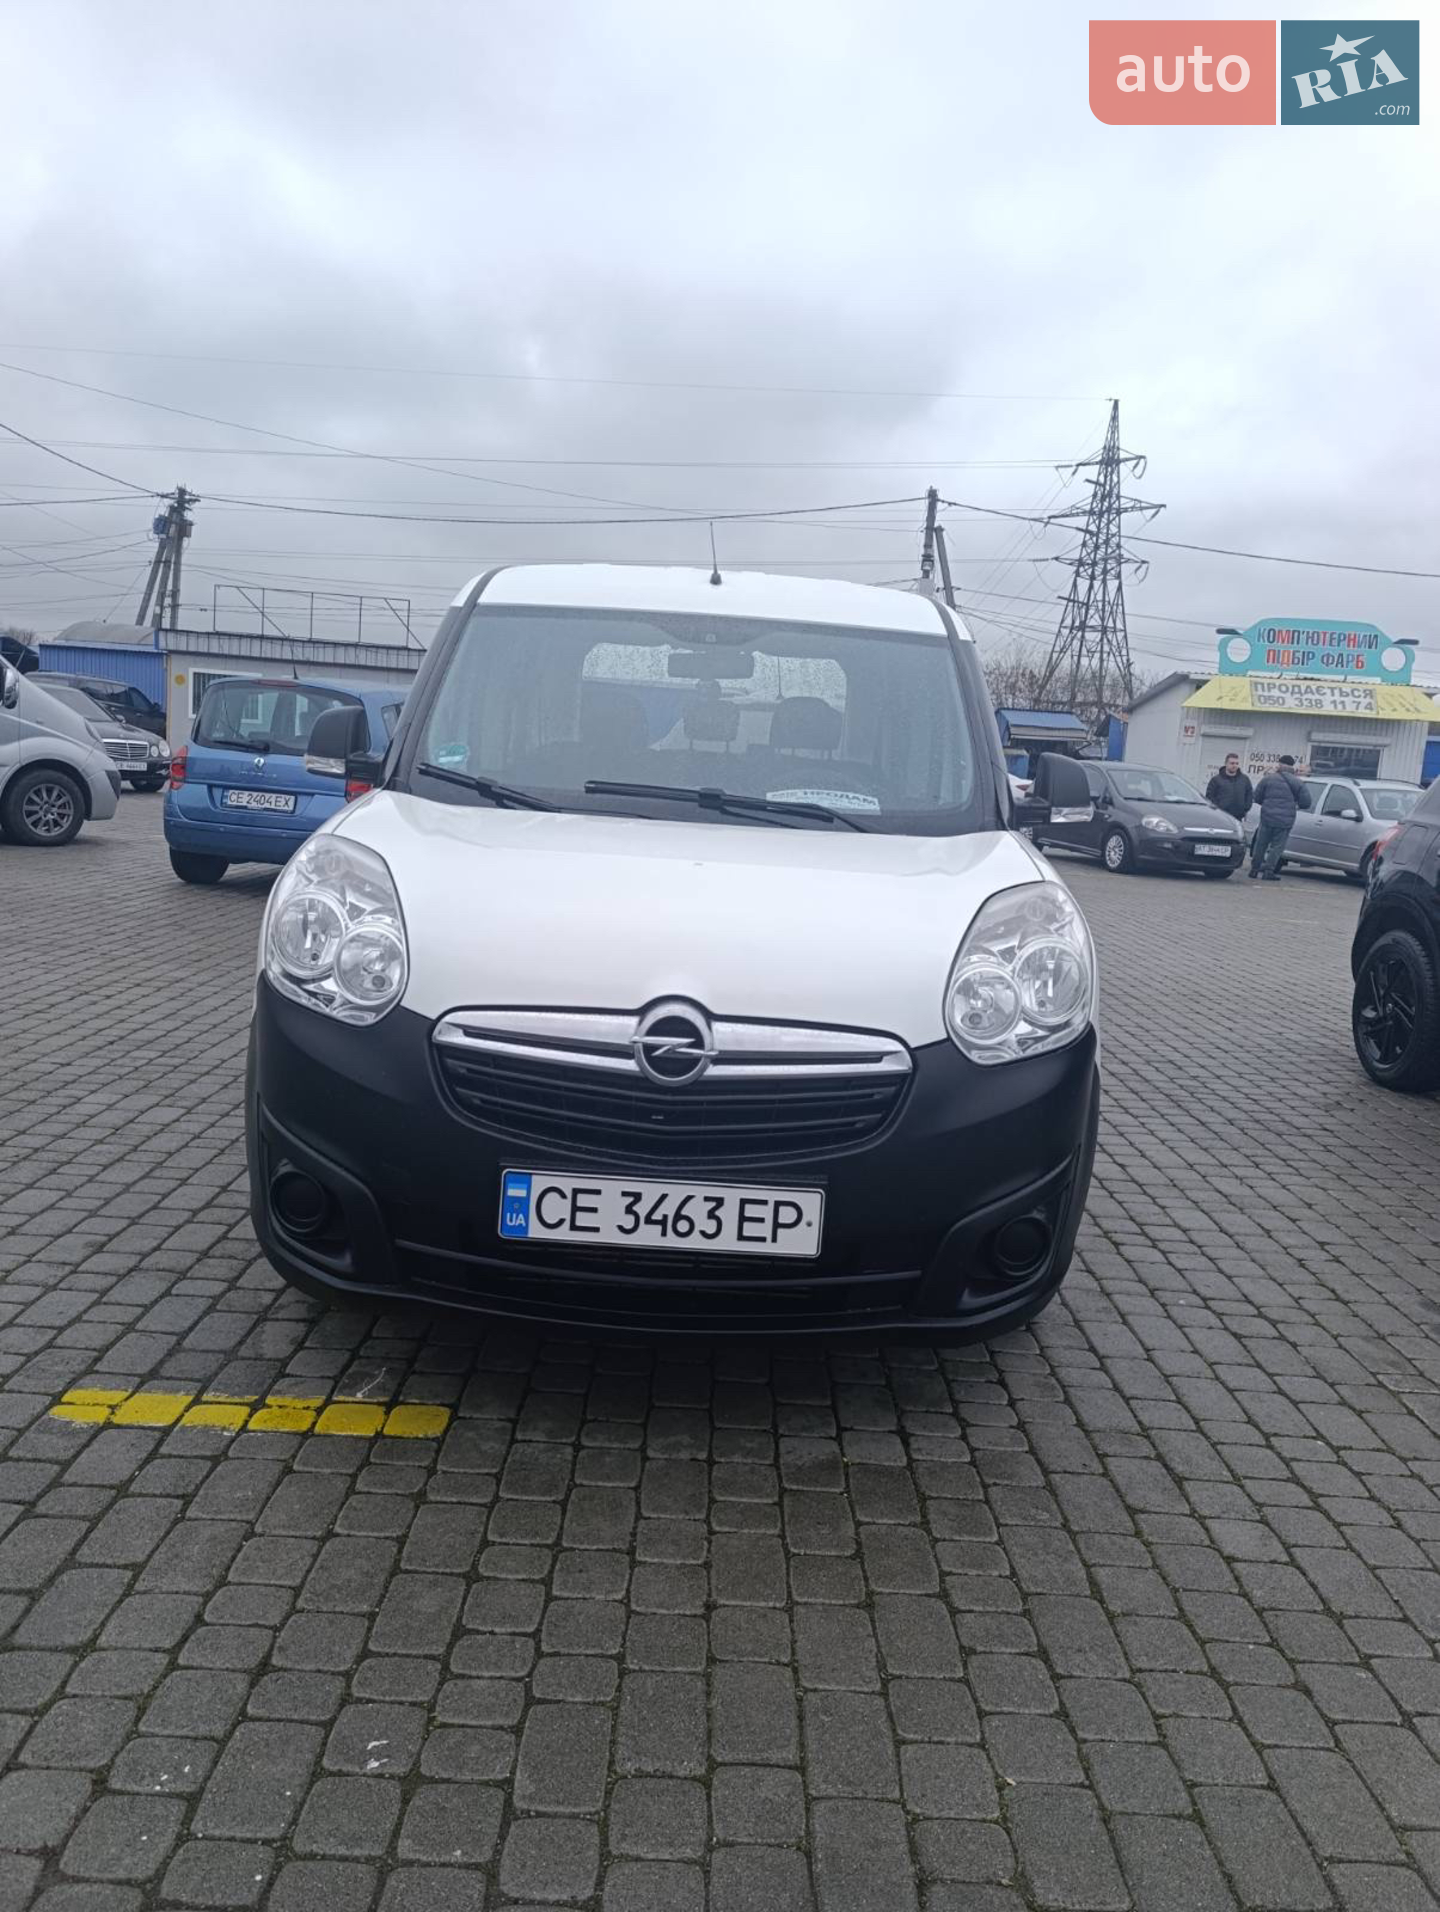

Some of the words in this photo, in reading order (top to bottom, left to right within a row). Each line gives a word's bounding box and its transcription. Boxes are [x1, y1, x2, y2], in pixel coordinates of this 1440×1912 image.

[1266, 649, 1316, 668] ПІДБІР
[1320, 652, 1366, 670] ФАРБ
[1253, 681, 1374, 700] ПРОДАЄТЬСЯ
[1257, 695, 1286, 706] 050
[1295, 698, 1323, 710] 338
[1331, 700, 1347, 711] 11
[229, 791, 244, 804] CE
[246, 793, 273, 807] 2404
[274, 795, 291, 808] EX
[506, 1212, 526, 1227] UA
[535, 1186, 602, 1233] CE
[616, 1190, 725, 1240] 3463
[736, 1197, 804, 1244] EP
